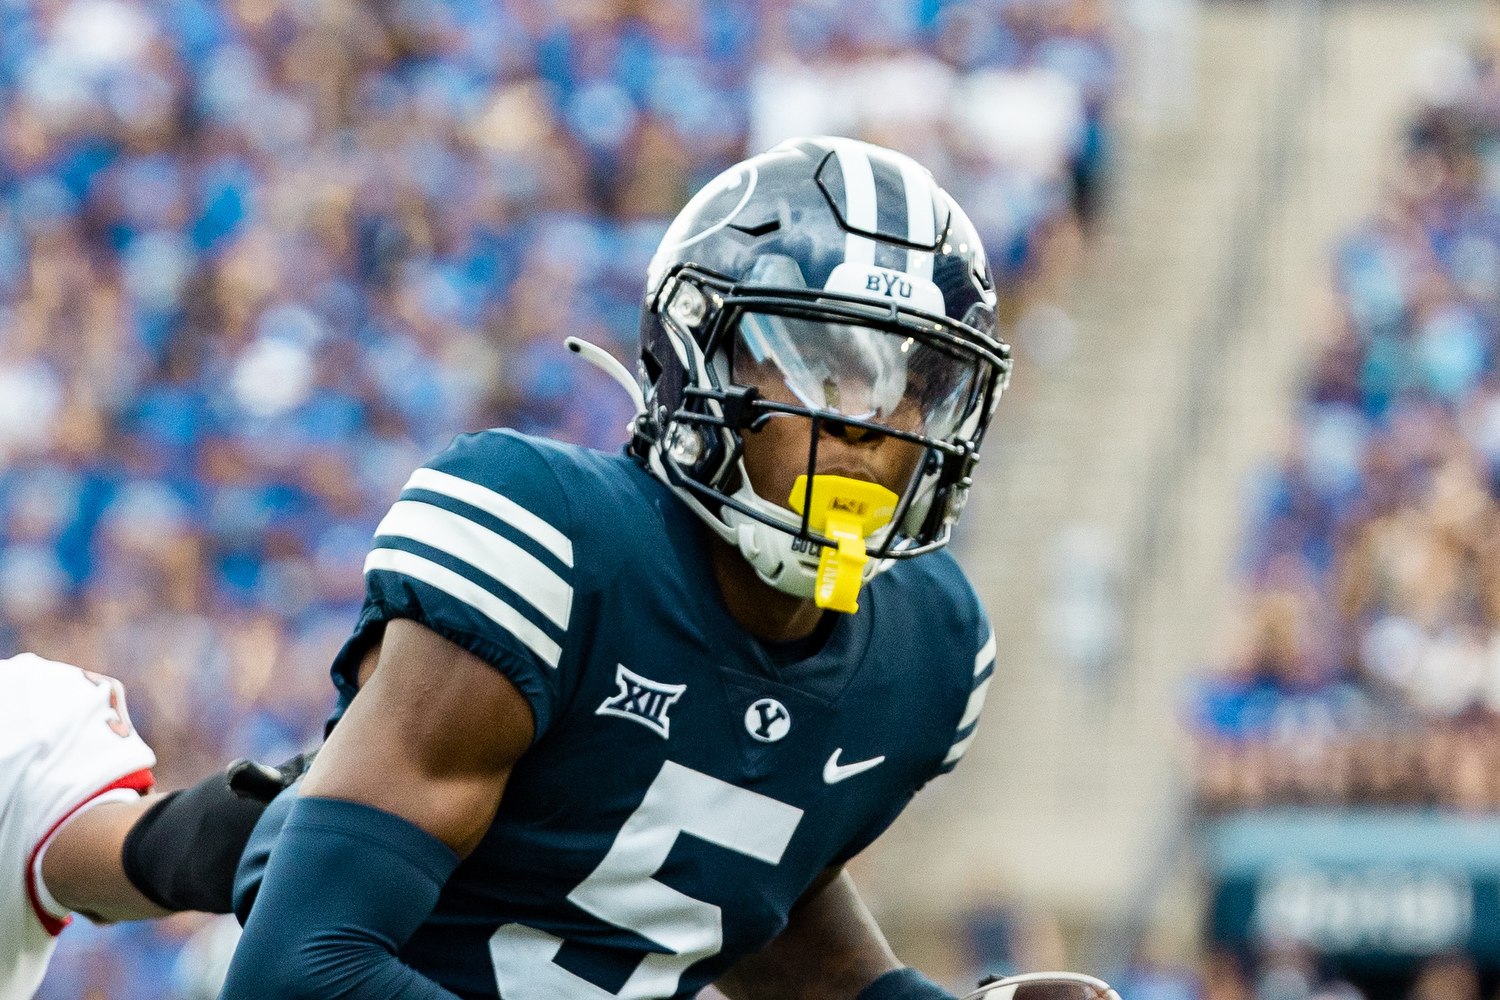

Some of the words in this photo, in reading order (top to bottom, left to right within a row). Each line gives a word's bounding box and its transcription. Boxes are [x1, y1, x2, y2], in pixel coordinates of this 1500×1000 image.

[865, 272, 913, 299] BYU
[603, 674, 681, 727] XII
[754, 702, 788, 739] Y
